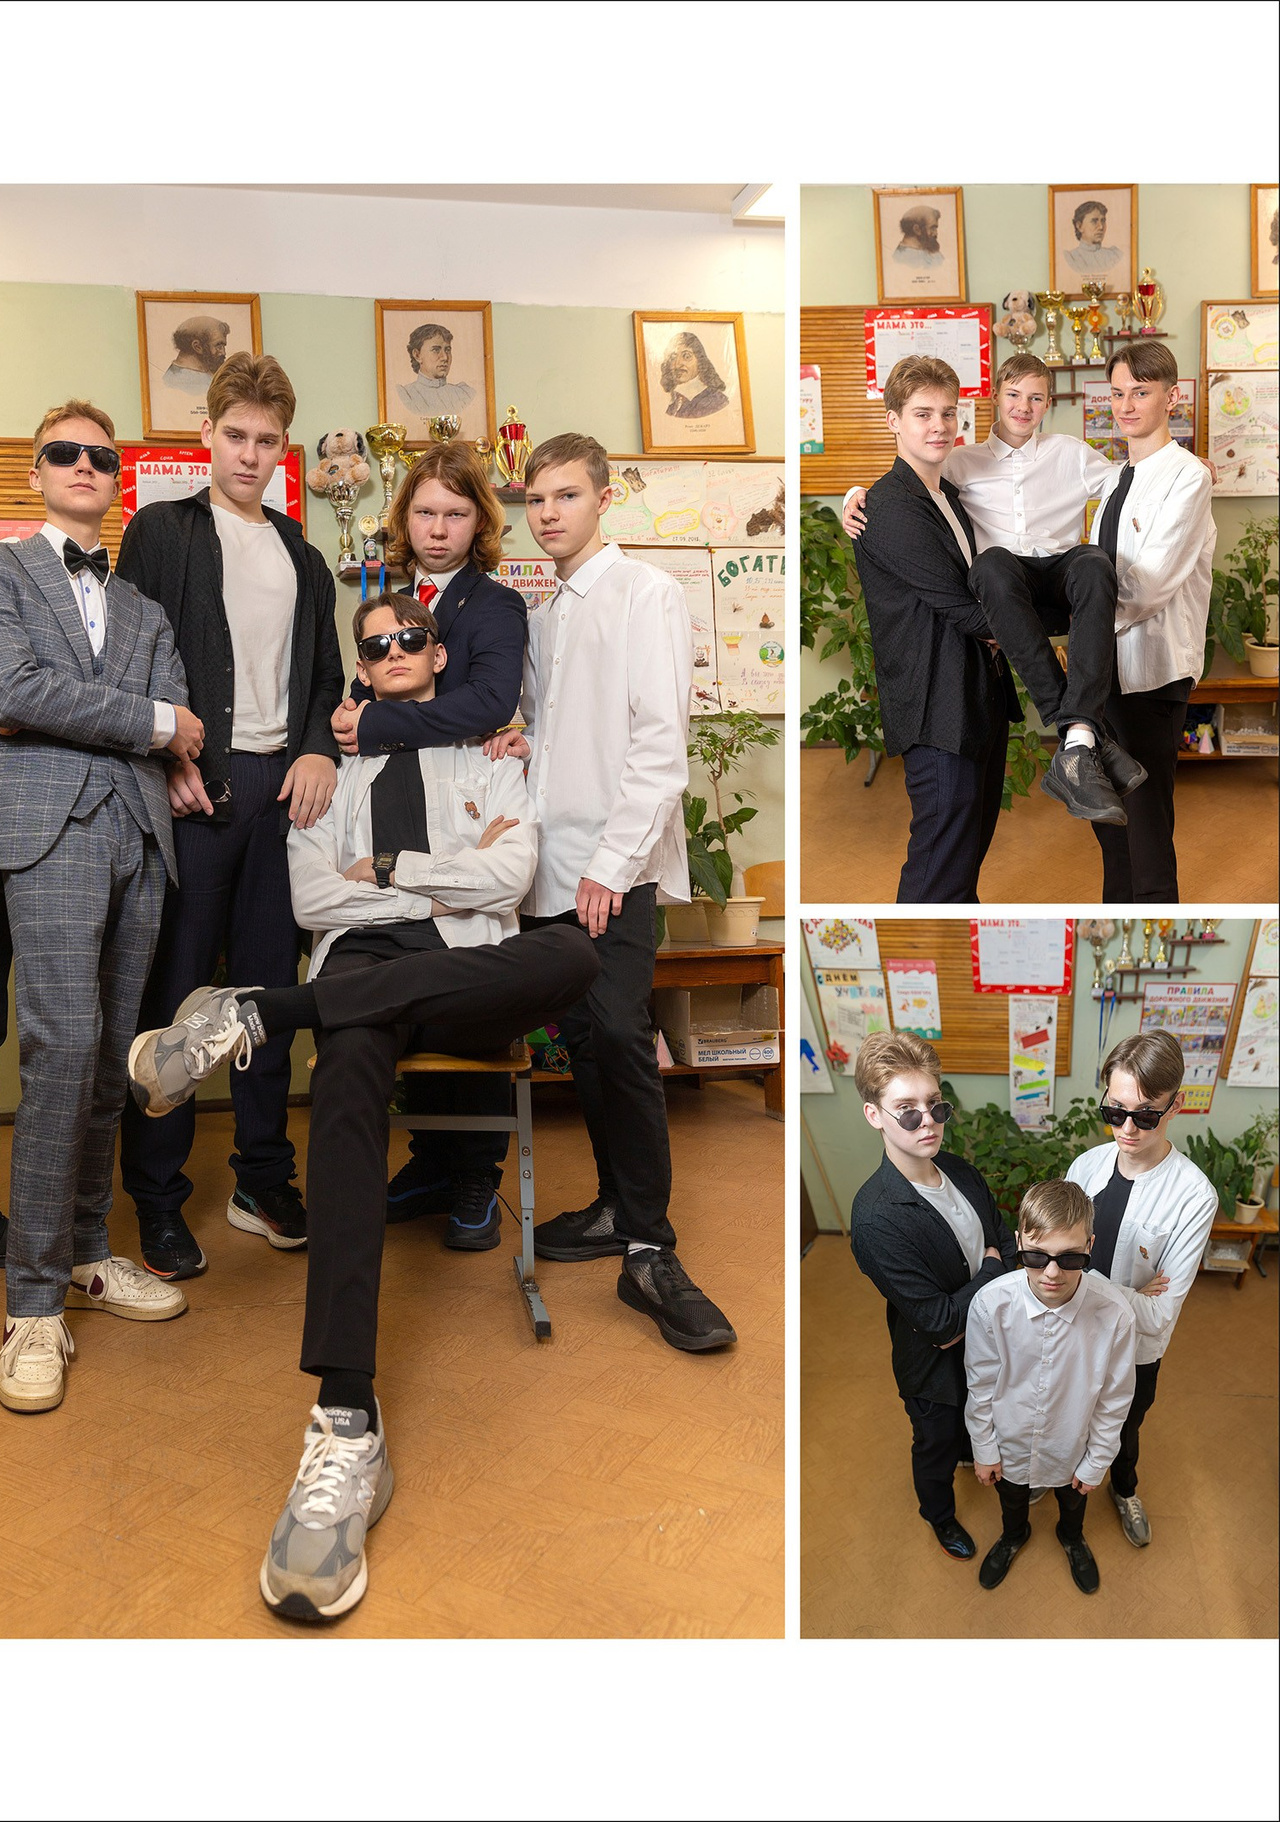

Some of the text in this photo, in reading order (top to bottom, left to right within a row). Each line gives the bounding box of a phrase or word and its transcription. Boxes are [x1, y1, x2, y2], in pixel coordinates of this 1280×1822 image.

[876, 321, 906, 330] МАМА
[140, 464, 182, 476] МАМА
[717, 554, 785, 588] БОГАТ
[512, 579, 556, 588] ДВИЖЕН
[1167, 986, 1214, 995] ПРАВИЛА
[334, 1417, 350, 1426] USA
